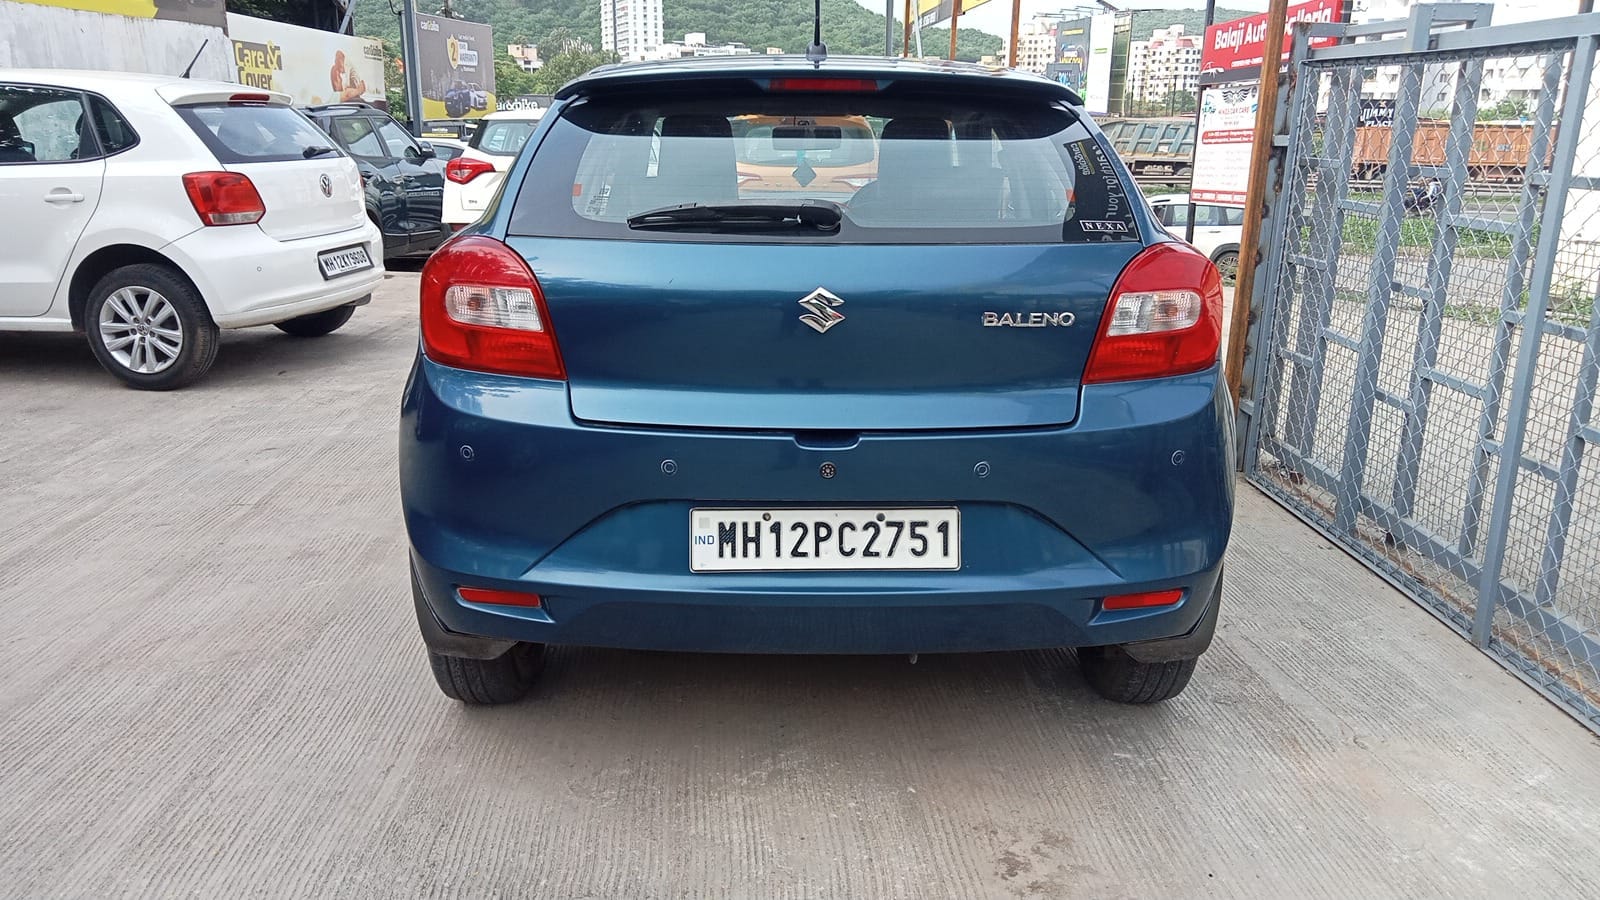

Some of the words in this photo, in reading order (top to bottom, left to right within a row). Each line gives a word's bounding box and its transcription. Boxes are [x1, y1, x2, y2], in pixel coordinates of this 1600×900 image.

[1214, 22, 1244, 53] Balaji
[1244, 20, 1268, 45] Aut
[235, 42, 265, 68] Care
[1085, 222, 1125, 230] NEXA
[983, 312, 1075, 327] BALENO
[694, 535, 715, 545] IND
[718, 521, 949, 558] MH12PC2751
